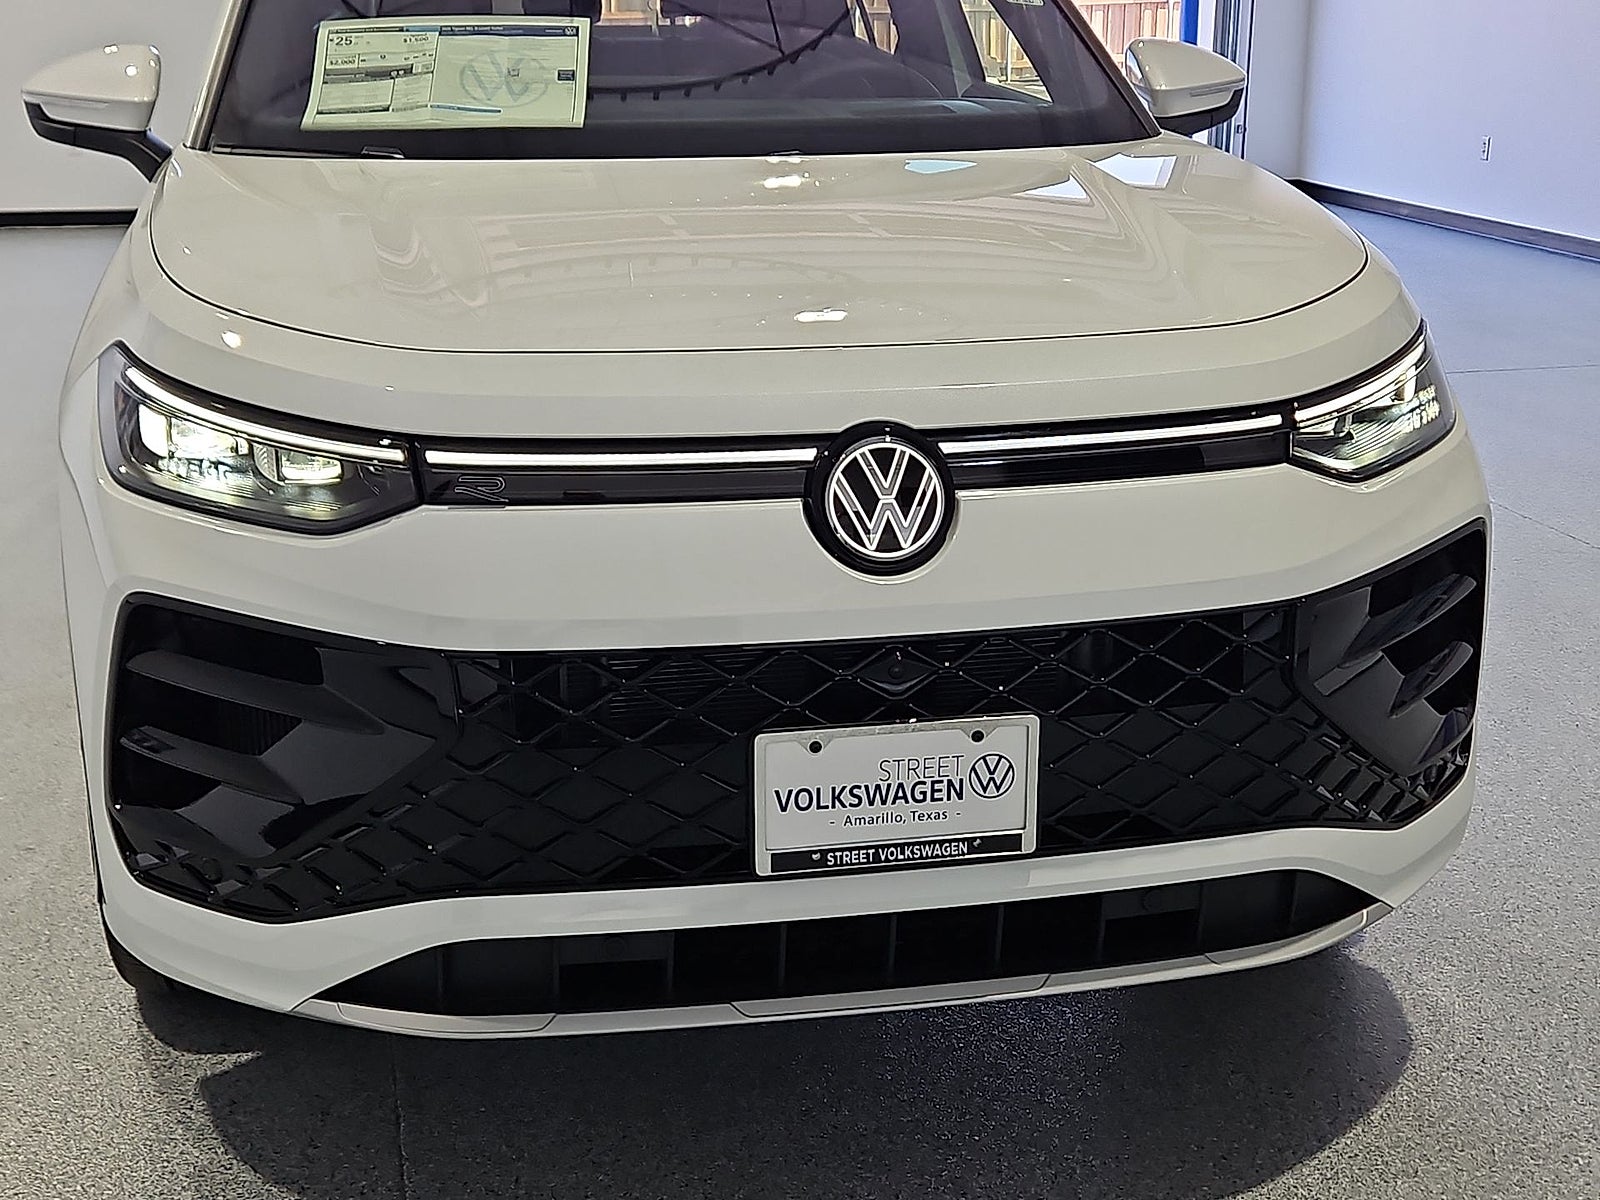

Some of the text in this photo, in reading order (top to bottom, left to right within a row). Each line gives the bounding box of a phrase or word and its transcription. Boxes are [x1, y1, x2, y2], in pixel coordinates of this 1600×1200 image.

[879, 754, 965, 782] STREET
[774, 778, 965, 813] VOLKSWAGEN
[843, 808, 948, 827] Amarillo, Texas
[826, 841, 968, 865] STREET VOLKSWAGEN
